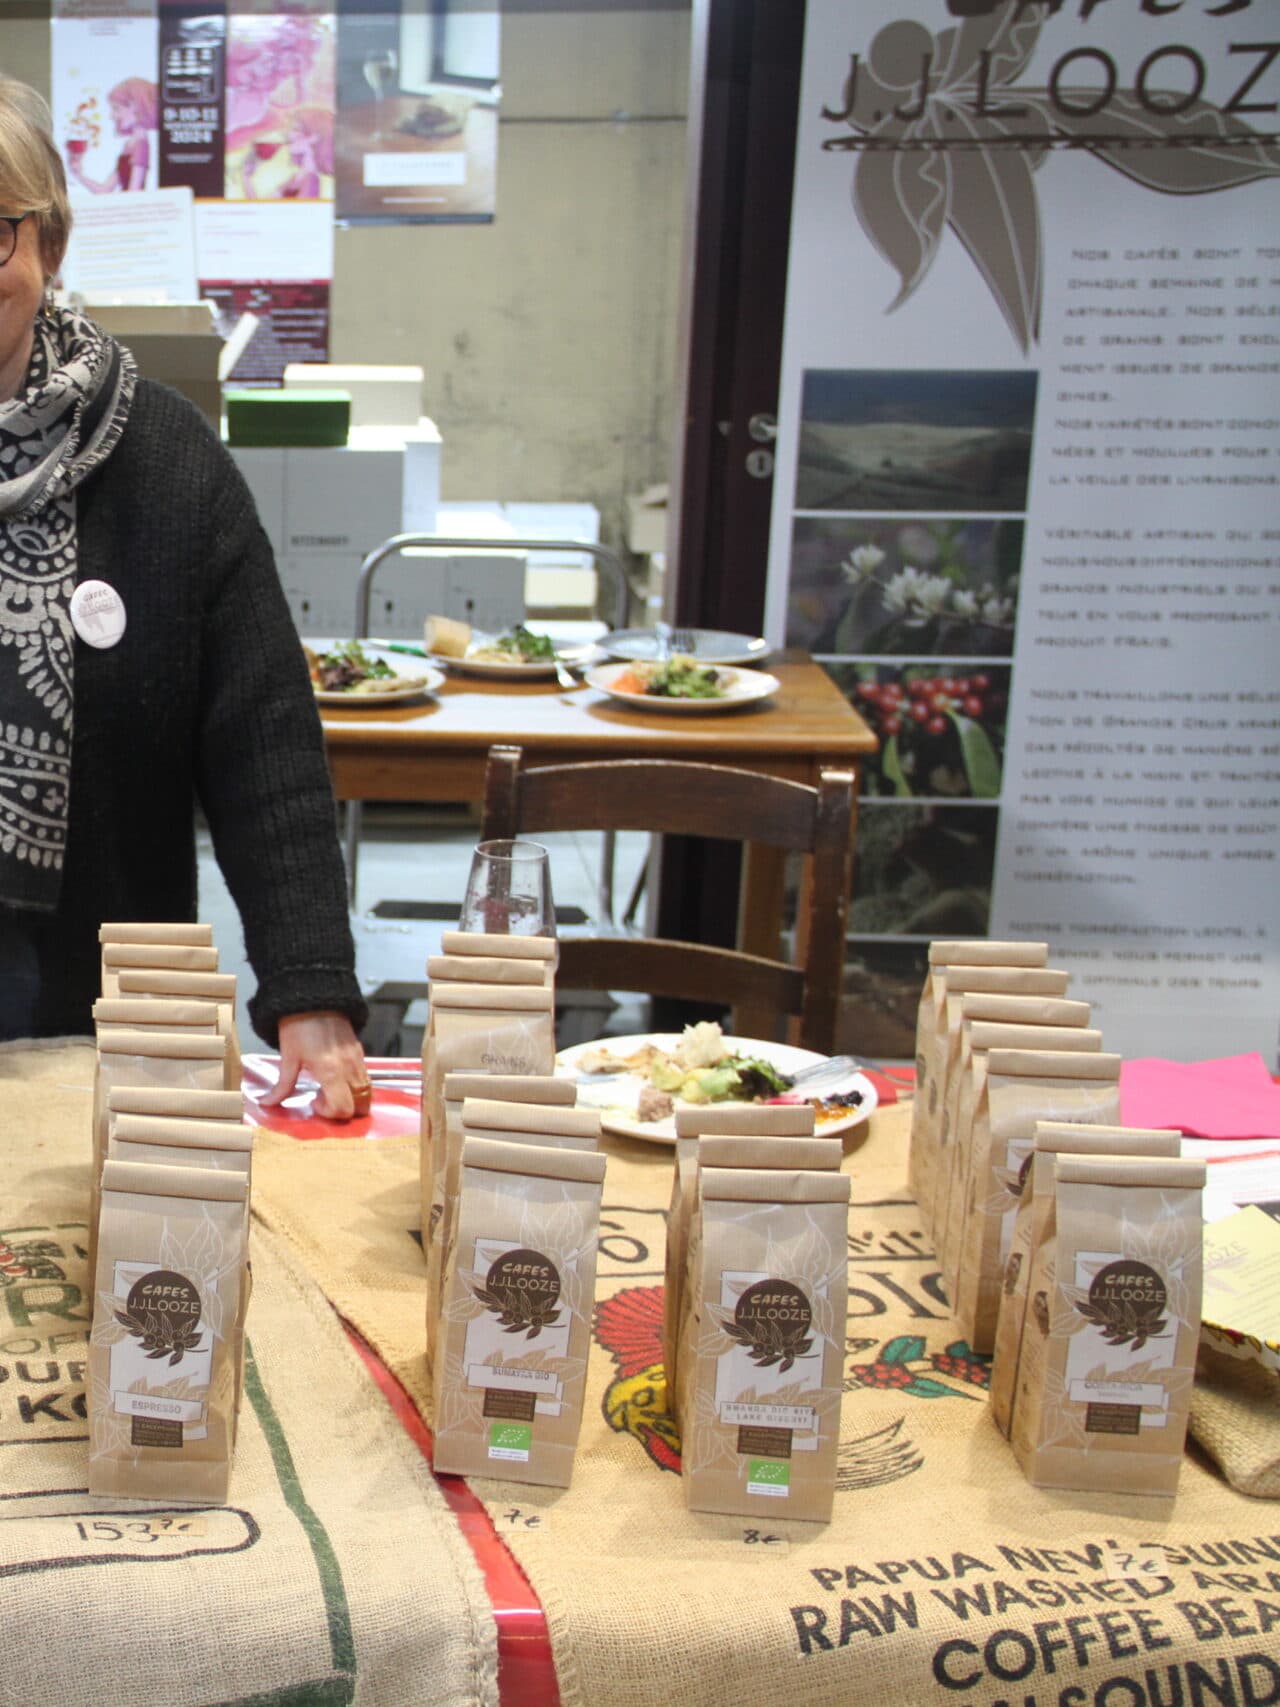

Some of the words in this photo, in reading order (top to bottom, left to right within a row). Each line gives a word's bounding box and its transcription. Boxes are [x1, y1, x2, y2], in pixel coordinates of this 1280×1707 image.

[501, 1263, 550, 1278] CAFES
[1104, 1273, 1155, 1287] CAFES
[141, 1285, 190, 1299] CAFES
[750, 1294, 800, 1306] CAFES
[809, 1550, 996, 1592] PAPUA
[789, 1590, 920, 1657] RAW
[930, 1576, 1176, 1622] WASHED
[932, 1607, 1173, 1691] COFFEE
